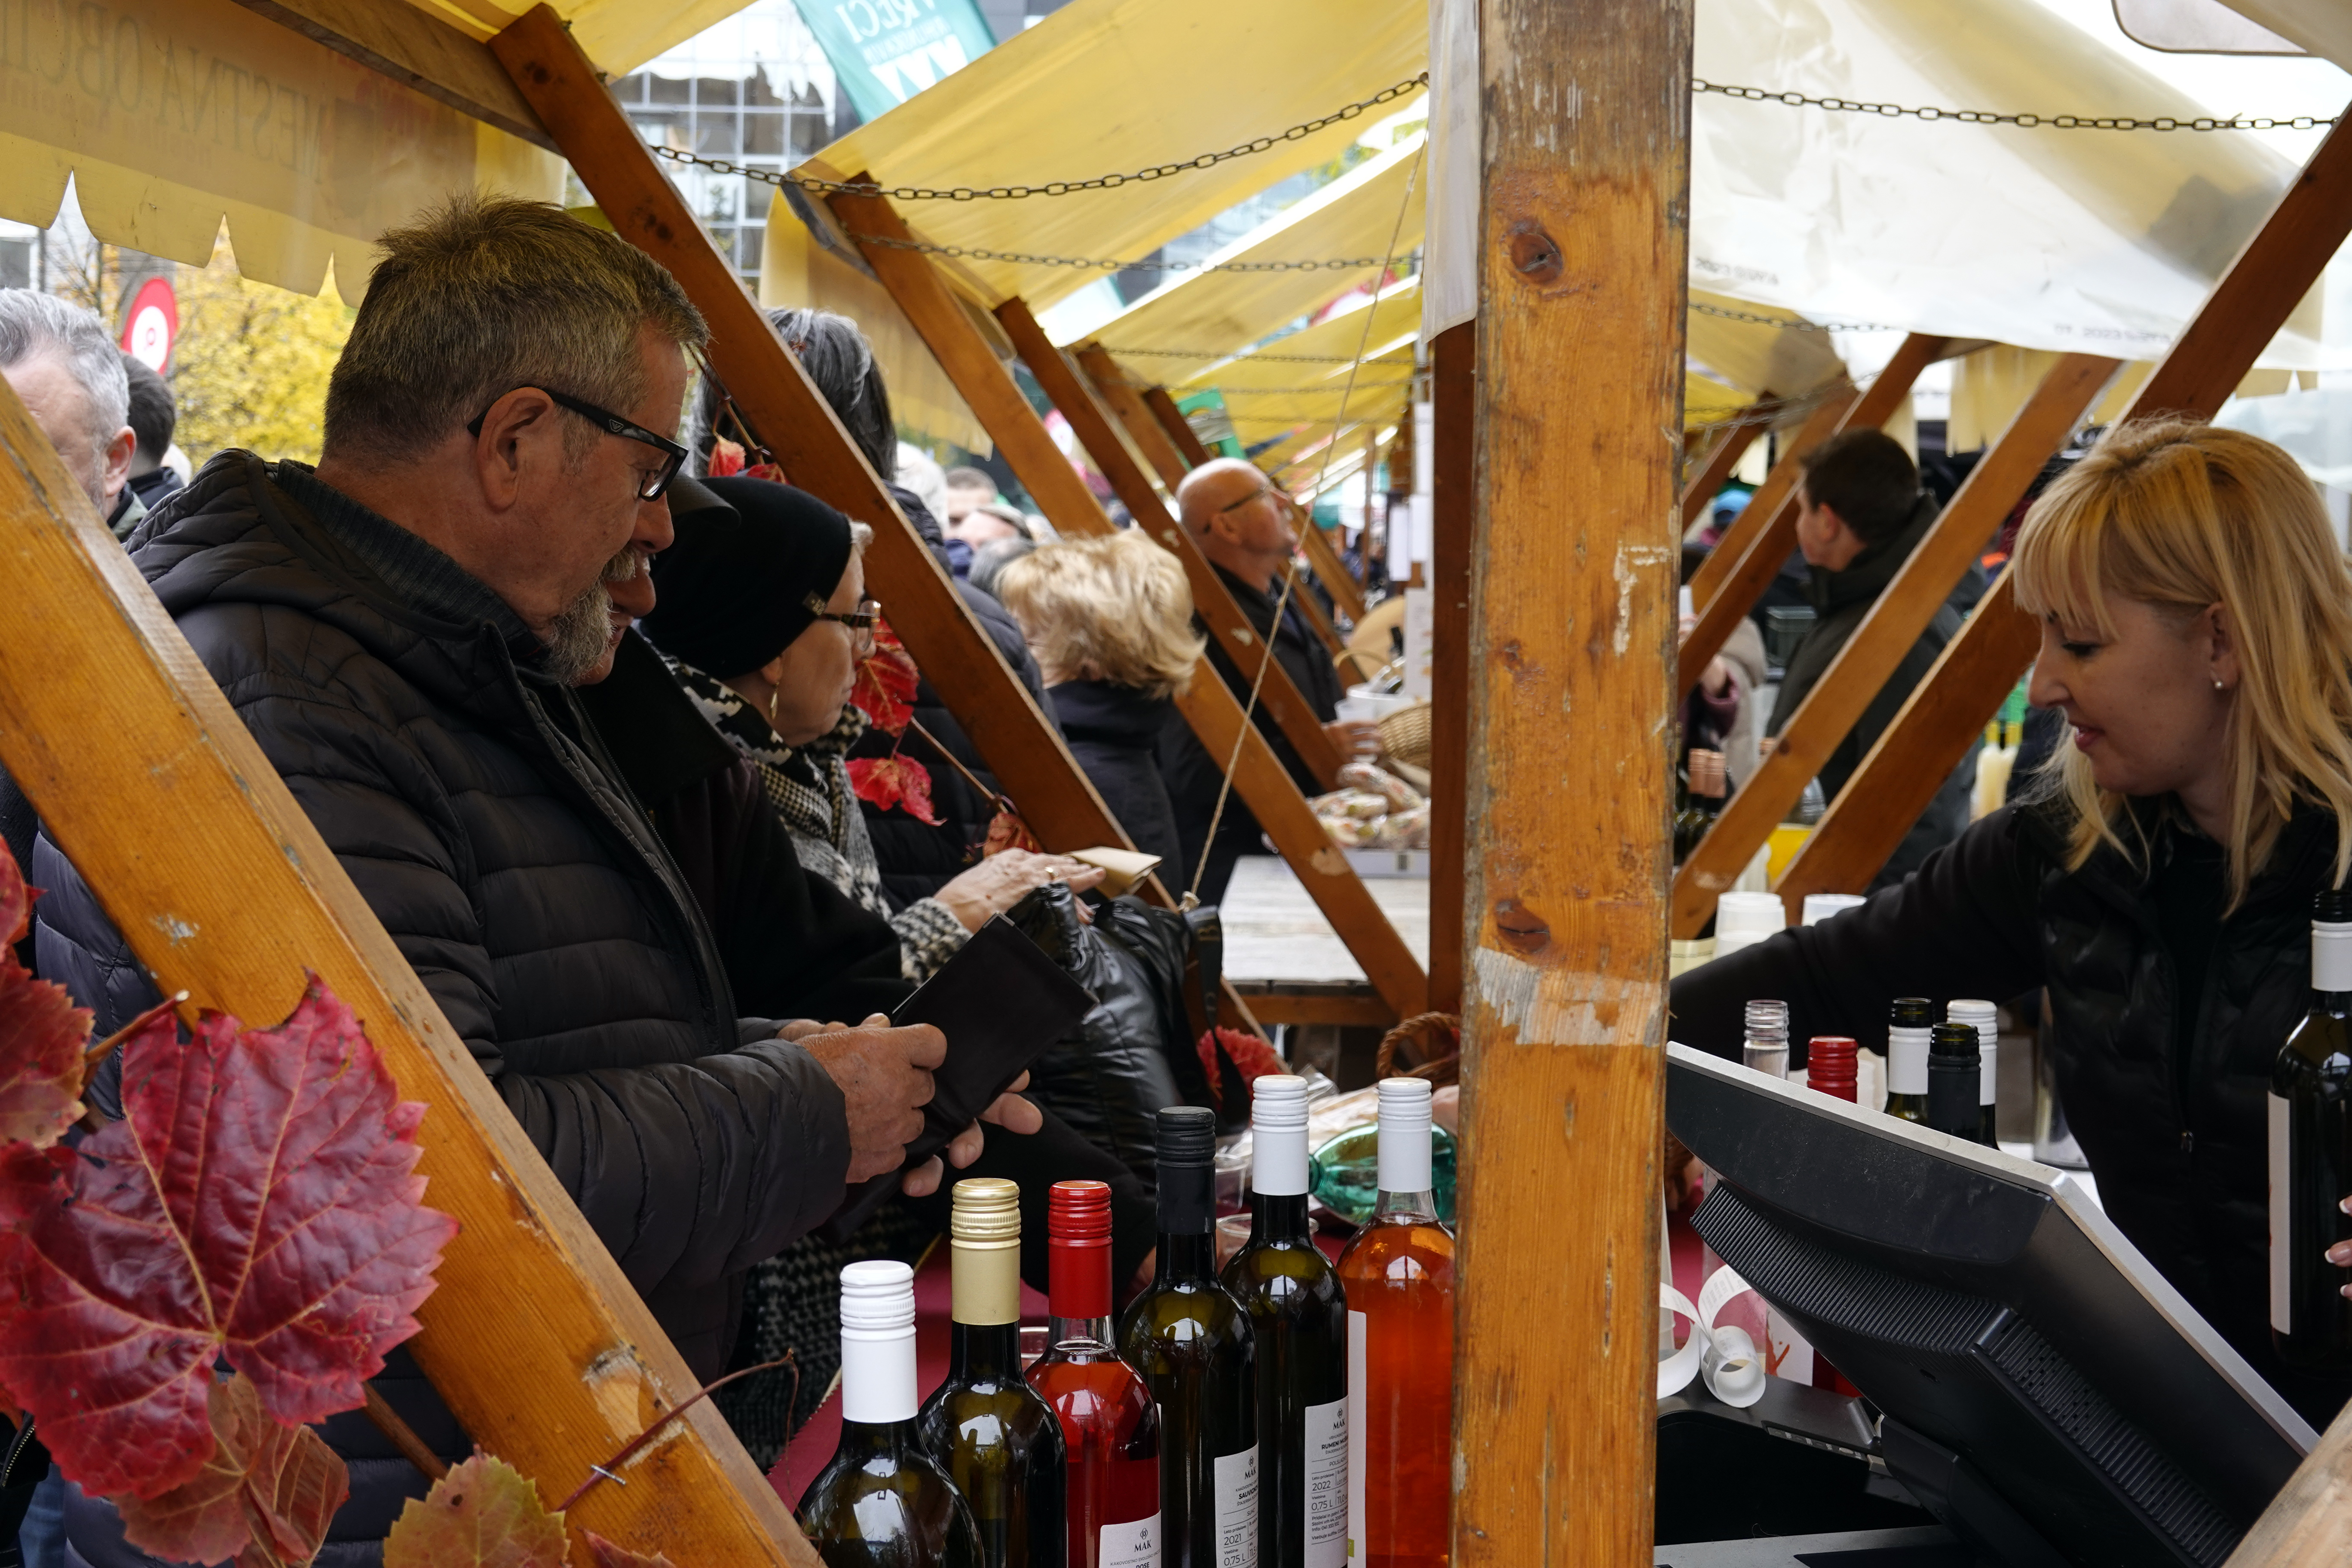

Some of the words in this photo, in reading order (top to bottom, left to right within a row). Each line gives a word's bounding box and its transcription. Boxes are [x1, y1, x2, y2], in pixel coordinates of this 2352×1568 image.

[1333, 1418, 1345, 1430] MAK
[1322, 1440, 1340, 1450] RUMENI
[1245, 1466, 1256, 1479] MAK
[1312, 1480, 1331, 1491] 2022
[1311, 1501, 1328, 1511] 0,75
[1329, 1499, 1333, 1507] L
[1134, 1539, 1152, 1552] MAK
[1224, 1534, 1241, 1546] 2021
[1110, 1558, 1138, 1566] KAKOVOSTNO
[1224, 1554, 1240, 1566] 0,75
[1242, 1553, 1246, 1562] L
